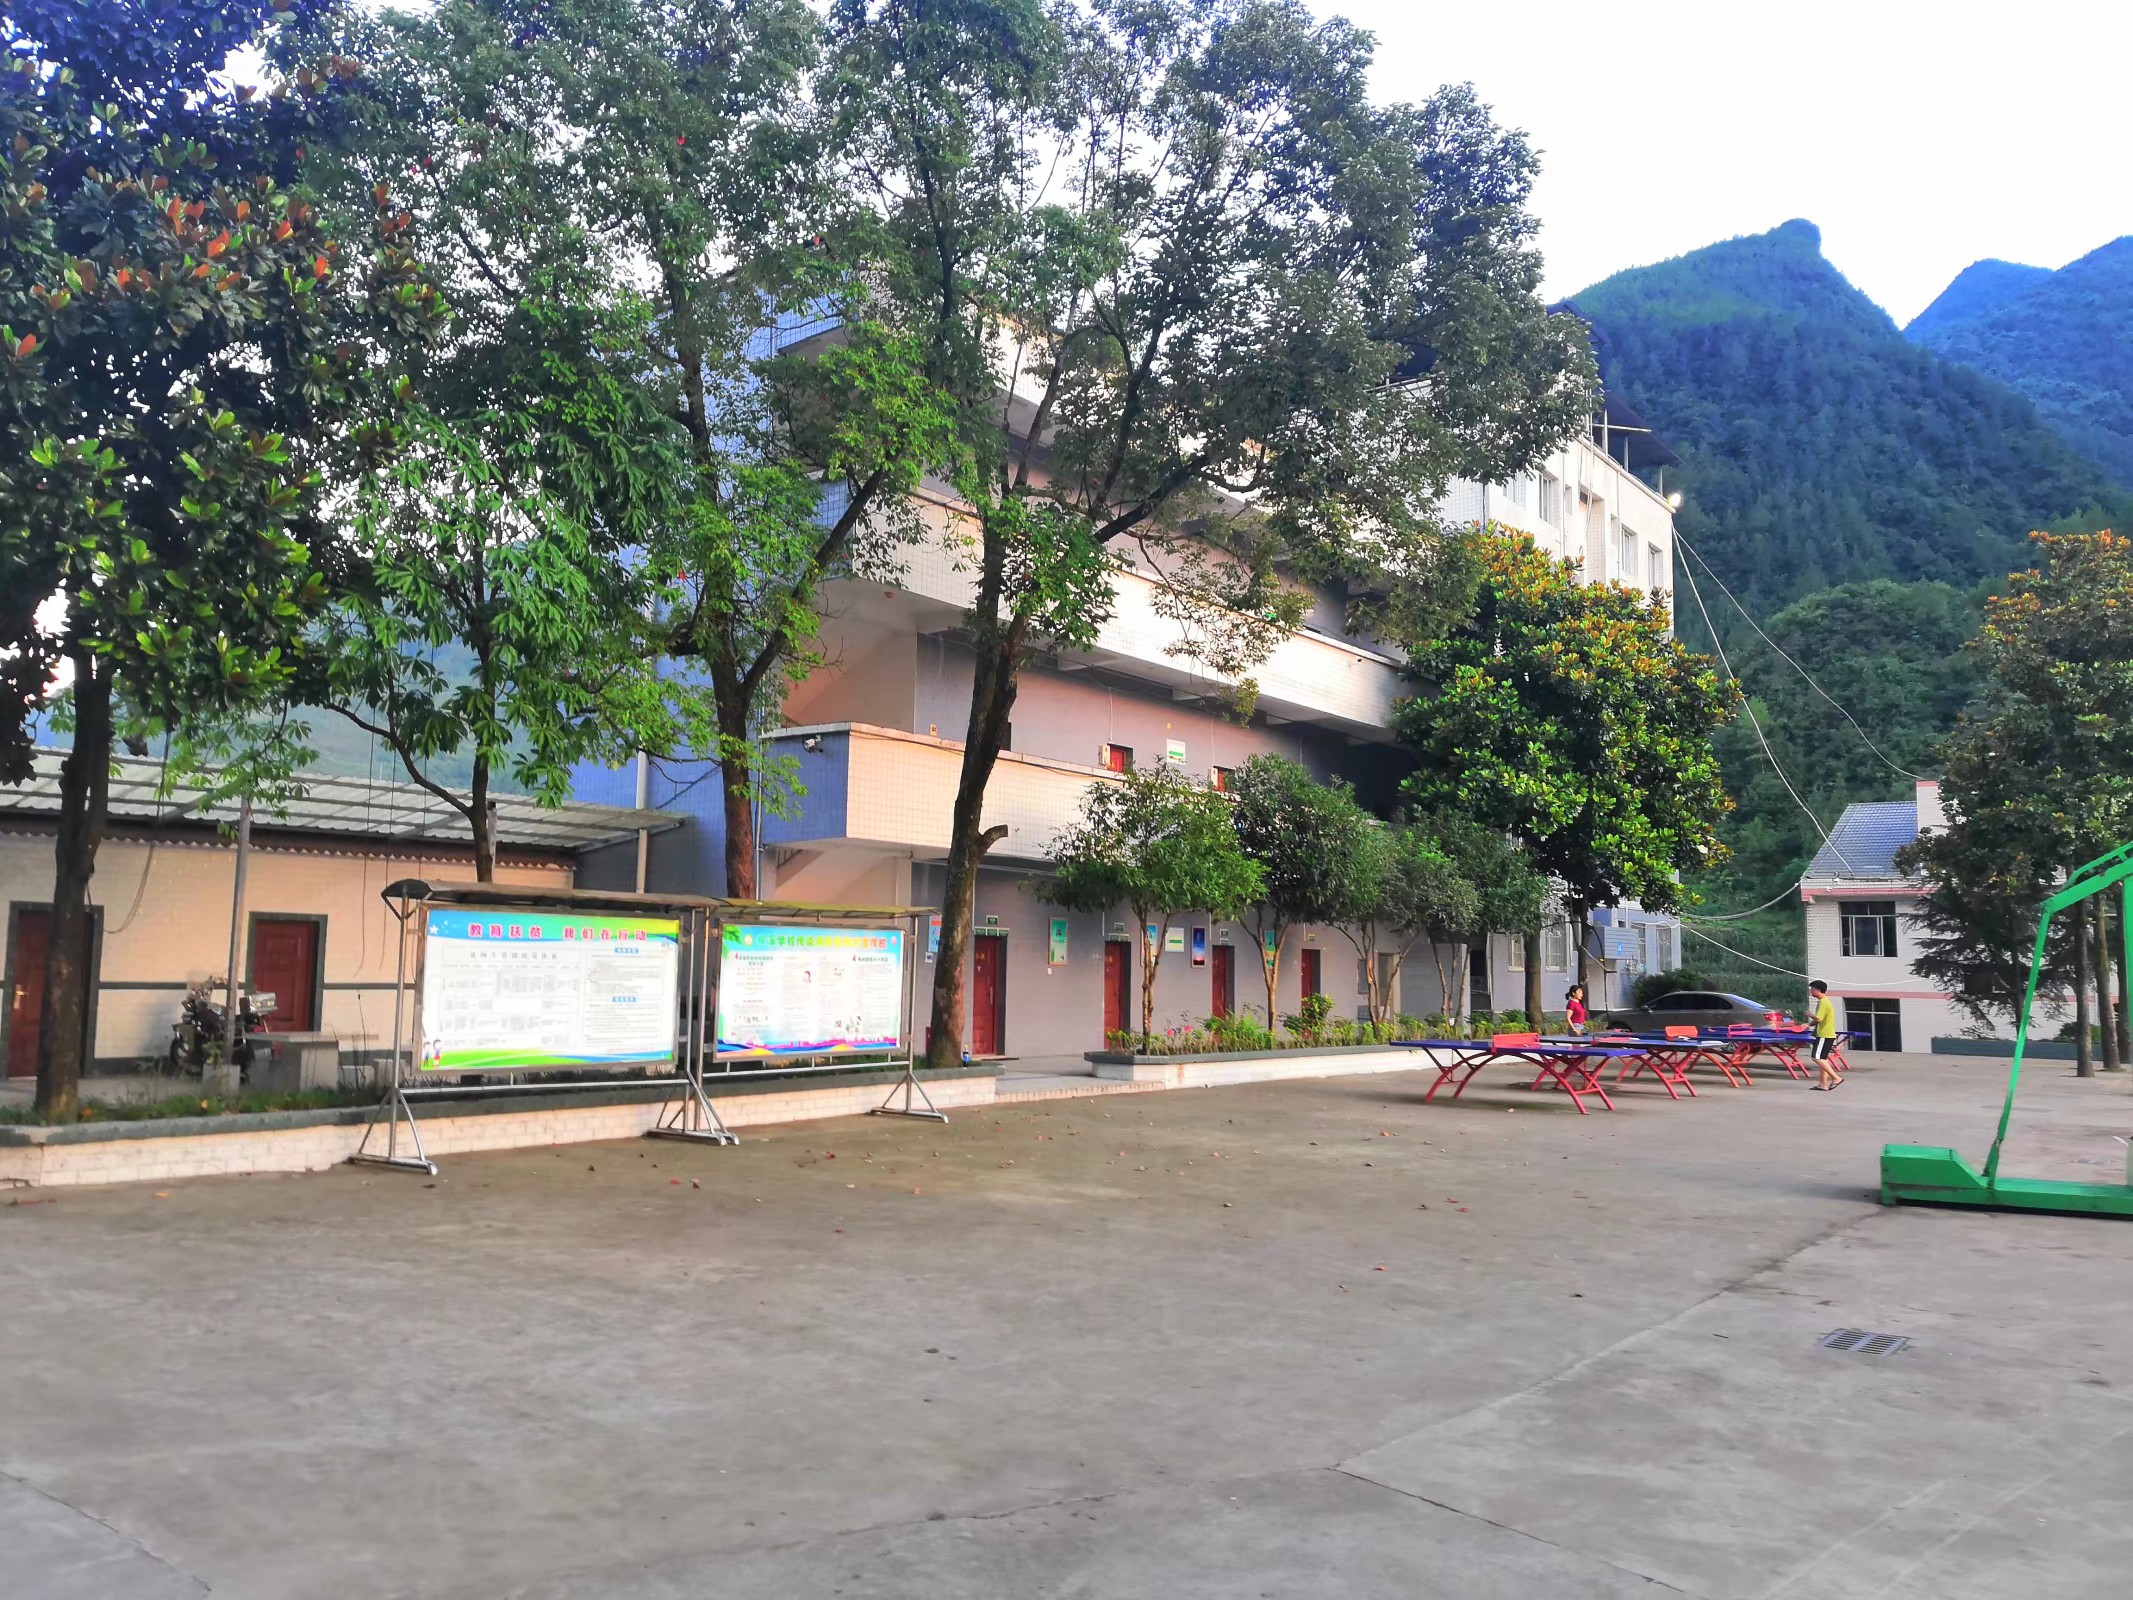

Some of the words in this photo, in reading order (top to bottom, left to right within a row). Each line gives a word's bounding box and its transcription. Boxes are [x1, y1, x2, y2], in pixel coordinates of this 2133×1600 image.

[468, 923, 542, 939] 教育扶贫
[562, 927, 648, 942] 我们在行动
